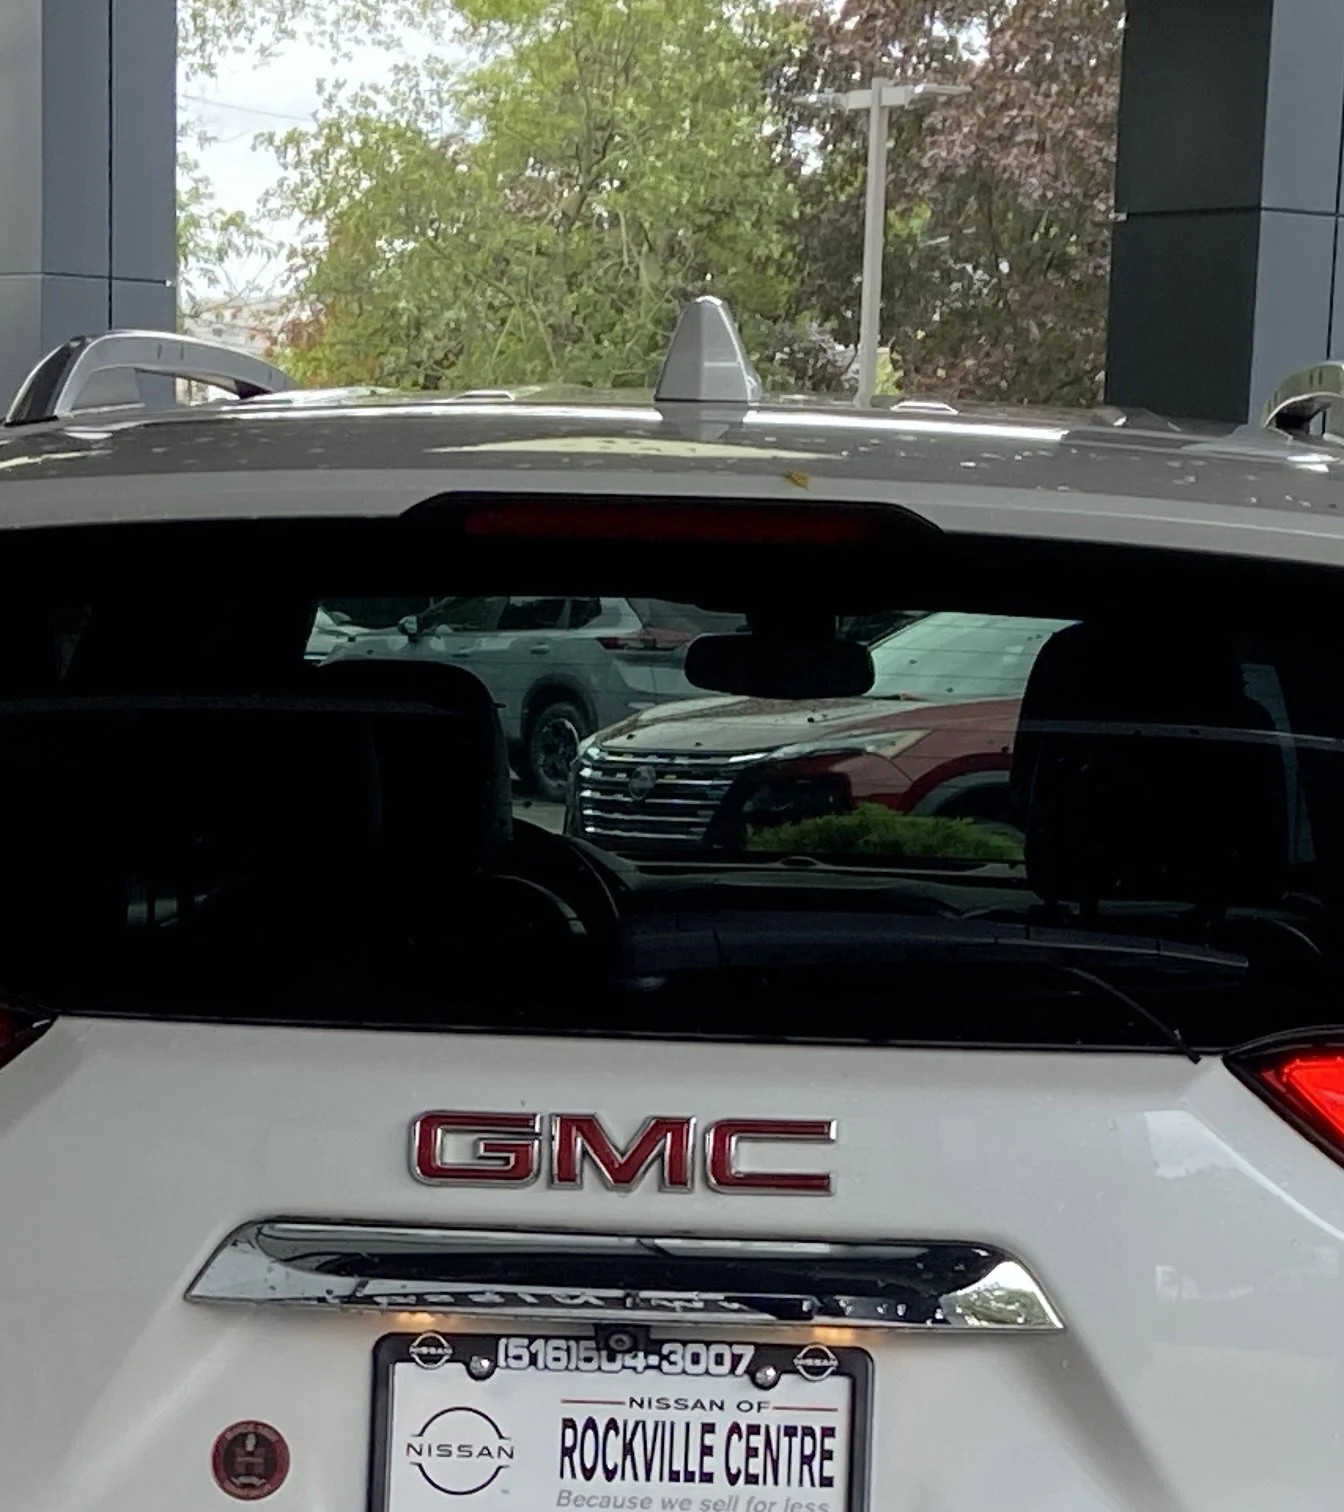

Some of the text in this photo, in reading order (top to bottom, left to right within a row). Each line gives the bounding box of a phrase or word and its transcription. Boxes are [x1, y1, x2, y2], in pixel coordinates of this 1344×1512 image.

[408, 1110, 838, 1197] GMC
[629, 1396, 771, 1413] NISSAN OF
[406, 1442, 515, 1460] NISSAN
[559, 1416, 837, 1488] ROCKVILLE CENTRE
[556, 1489, 654, 1511] Because
[661, 1497, 692, 1512] we
